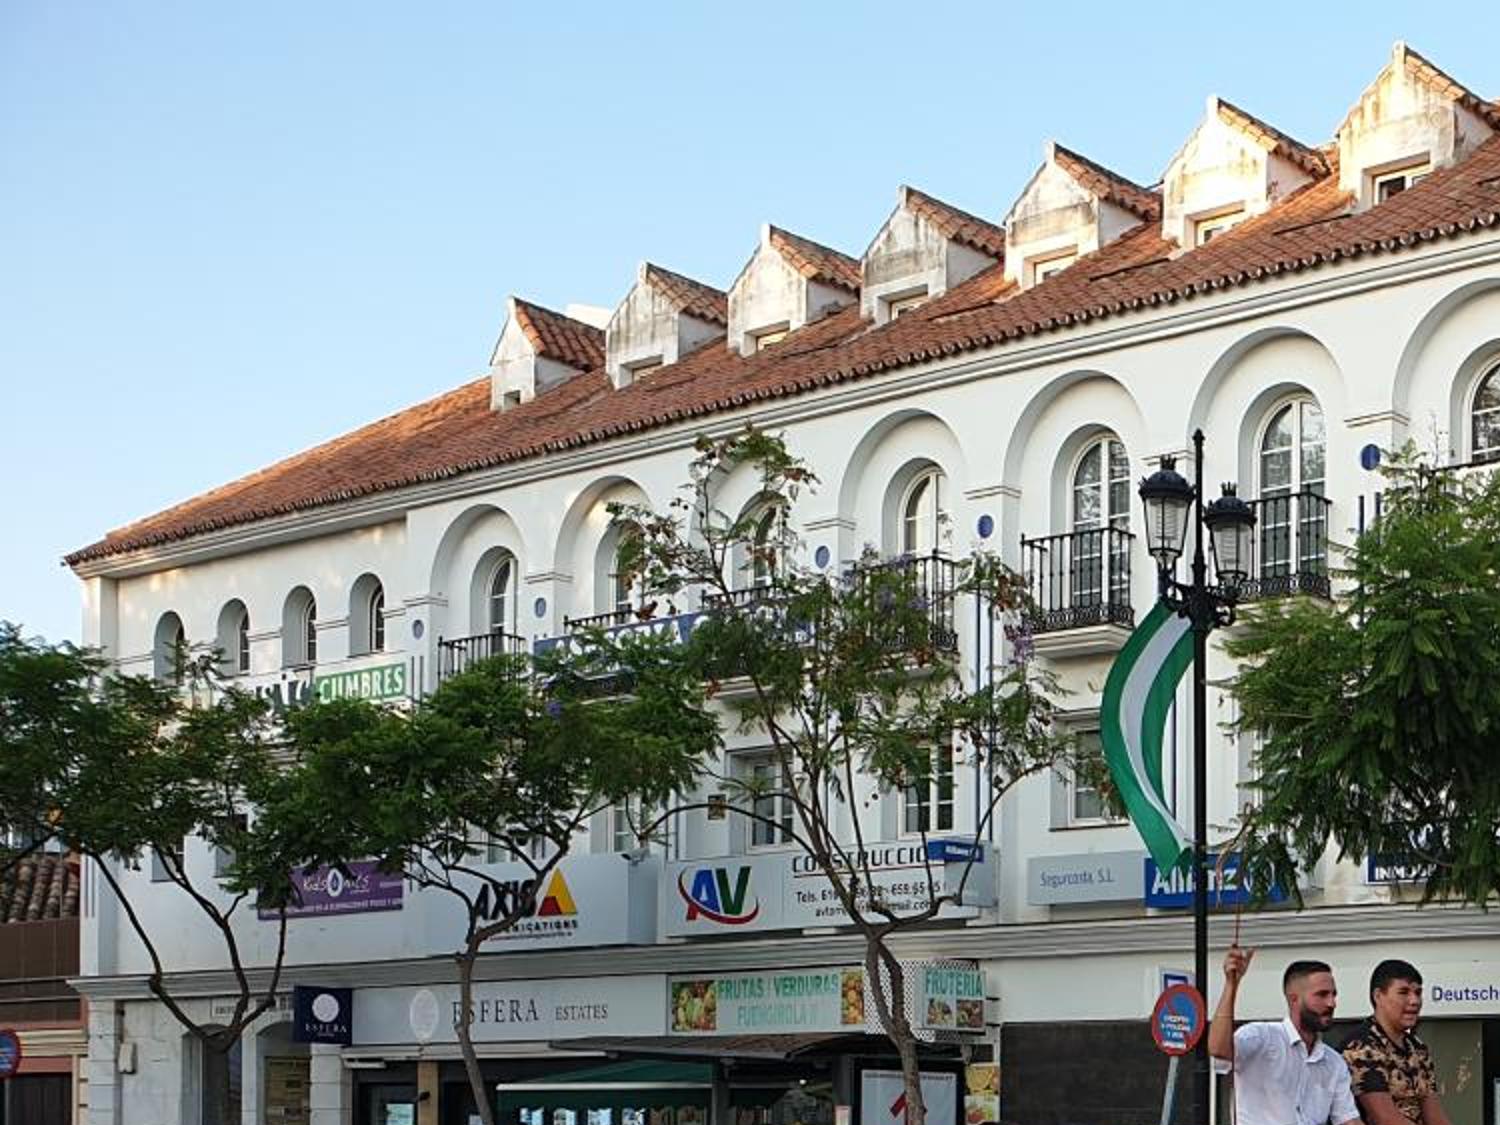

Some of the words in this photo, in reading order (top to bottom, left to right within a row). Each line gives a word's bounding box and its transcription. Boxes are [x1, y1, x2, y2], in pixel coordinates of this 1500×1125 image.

[318, 665, 404, 705] CUMBRES
[689, 865, 752, 917] AV
[717, 976, 764, 1000] FRUTAS
[773, 973, 839, 998] VERDURAS
[555, 1003, 609, 1021] ESTATES
